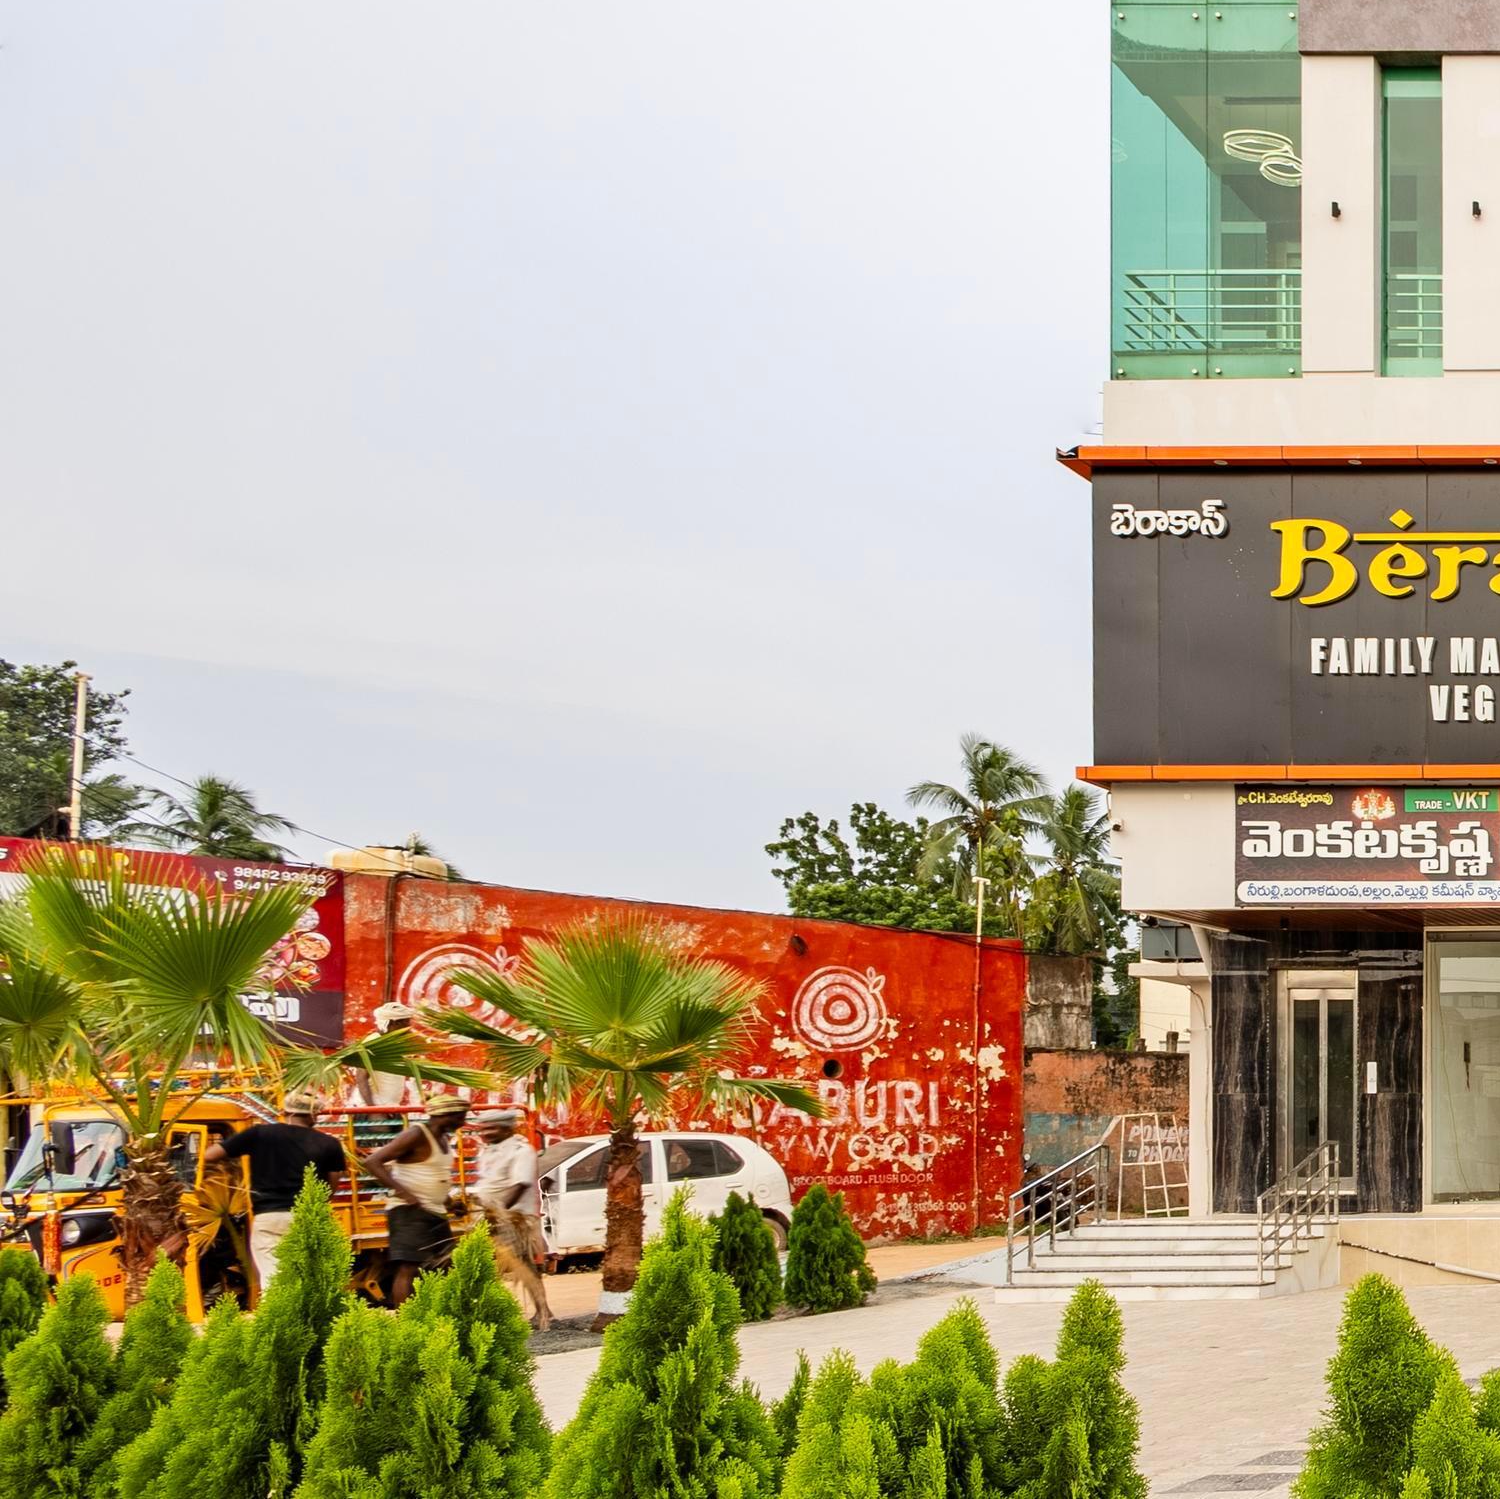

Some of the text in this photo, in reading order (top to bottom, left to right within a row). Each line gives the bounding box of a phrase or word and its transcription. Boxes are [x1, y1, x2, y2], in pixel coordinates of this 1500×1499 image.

[1309, 635, 1436, 676] FAMILY
[1428, 682, 1495, 722] VEG
[1414, 800, 1443, 810] TRADE
[1453, 791, 1489, 811] VKT
[1240, 819, 1494, 877] వెంకటకృష్ణ
